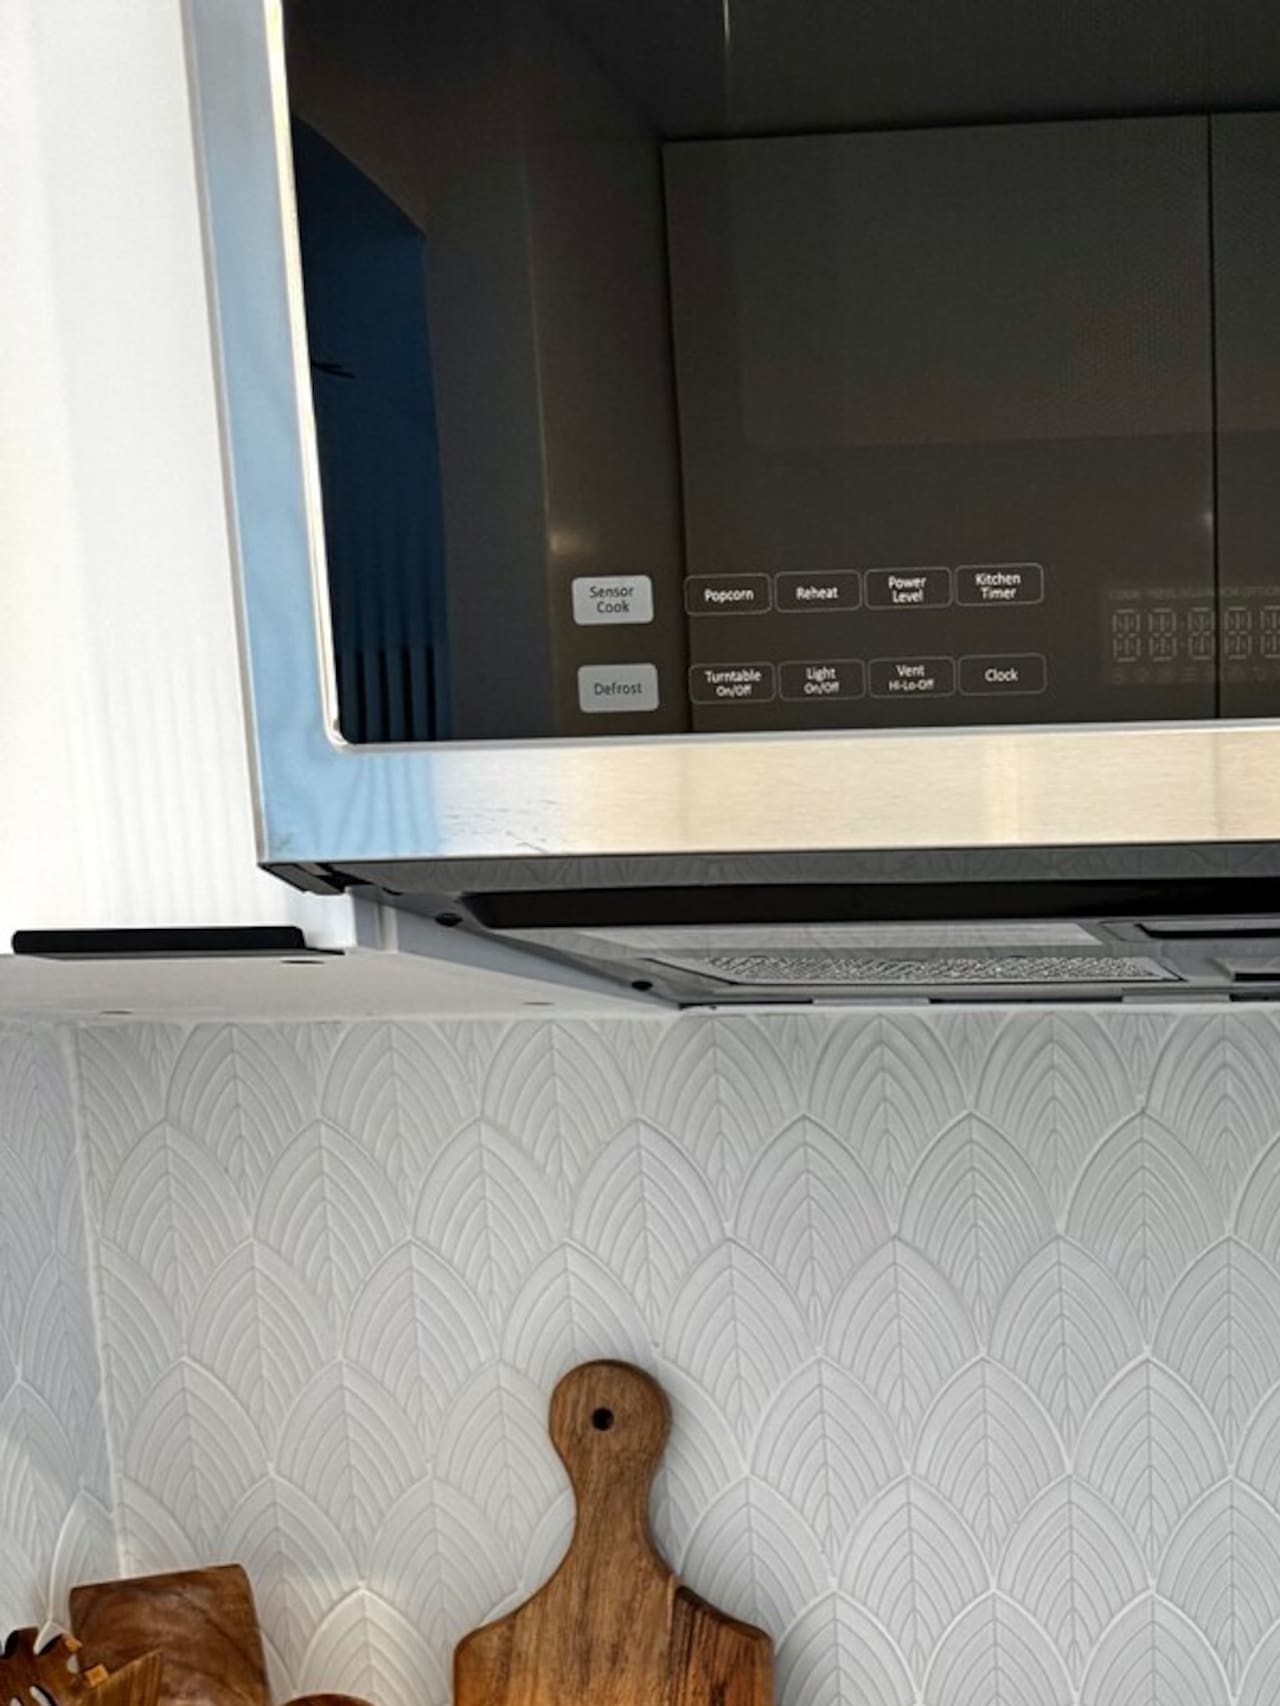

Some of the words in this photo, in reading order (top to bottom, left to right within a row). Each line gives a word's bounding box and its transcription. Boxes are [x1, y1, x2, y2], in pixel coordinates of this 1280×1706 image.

[888, 575, 927, 588] Power
[975, 572, 1021, 586] Kitchen
[589, 585, 634, 598] Sensor
[704, 588, 754, 604] Popcorn
[796, 586, 838, 600] Reheat
[892, 589, 924, 603] Level
[980, 588, 1017, 600] Timer
[596, 600, 630, 614] Cook
[705, 669, 762, 684] Turntable
[806, 666, 836, 682] Light
[895, 664, 925, 678] Vent
[984, 667, 1018, 682] Clock
[593, 681, 643, 696] Defrost
[715, 684, 752, 697] On/Off
[803, 682, 840, 695] On/Off
[888, 678, 935, 691] Hi-Lo-Off
